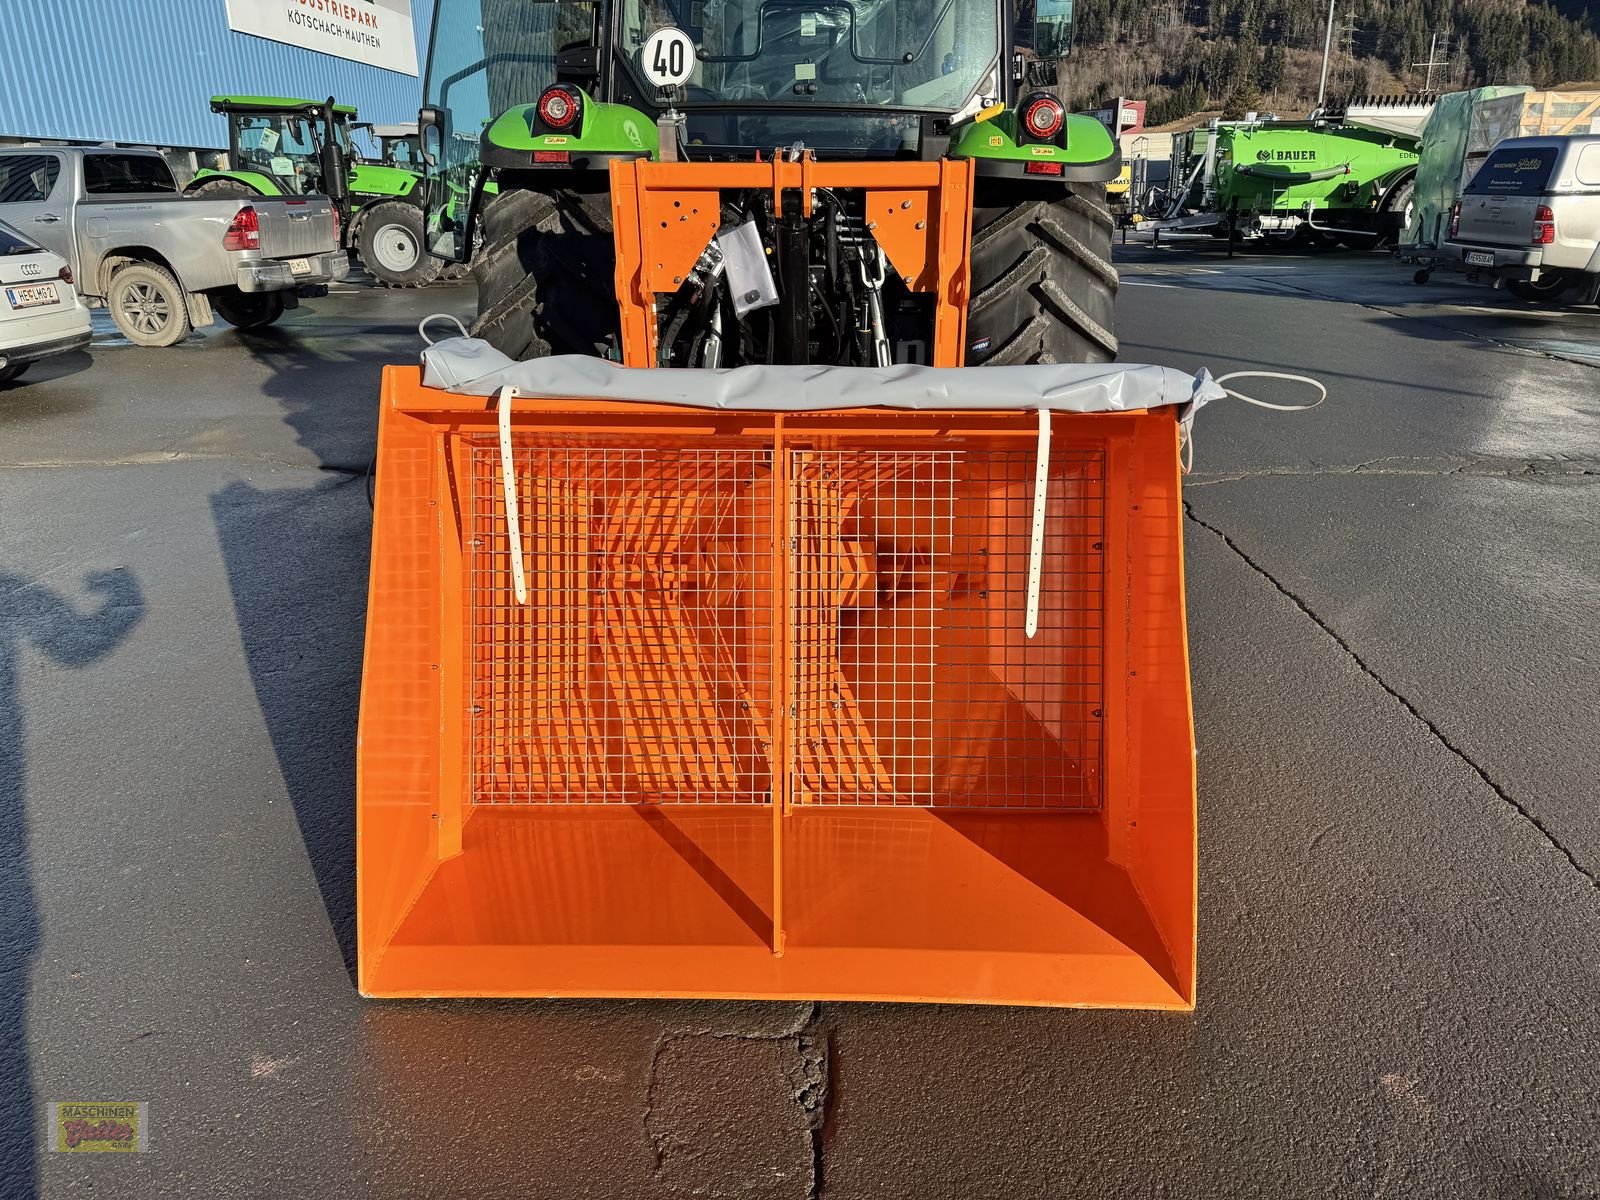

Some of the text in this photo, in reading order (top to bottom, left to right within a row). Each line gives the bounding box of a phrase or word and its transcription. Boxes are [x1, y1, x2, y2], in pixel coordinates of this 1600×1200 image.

[653, 39, 684, 77] 40
[1276, 150, 1316, 160] BAUER
[18, 289, 30, 302] HE
